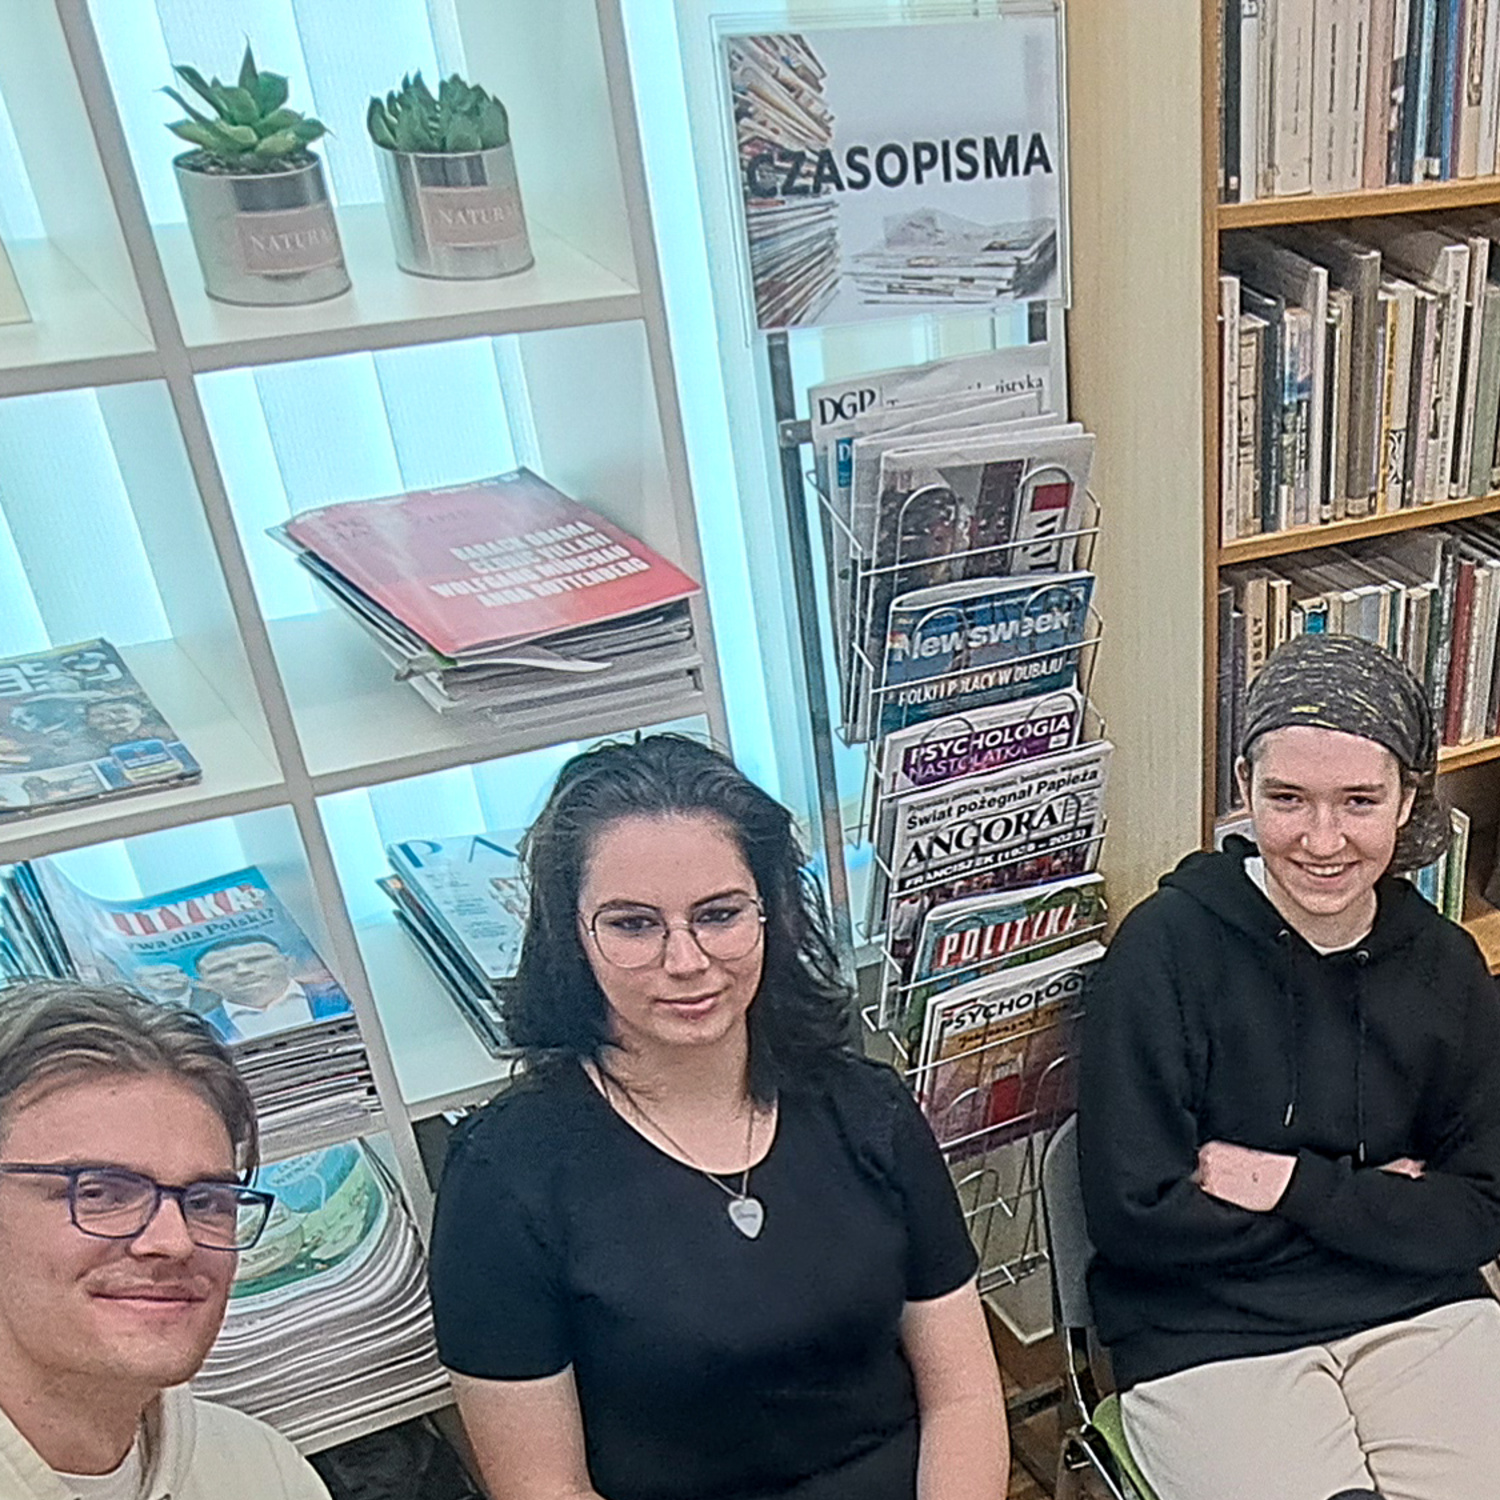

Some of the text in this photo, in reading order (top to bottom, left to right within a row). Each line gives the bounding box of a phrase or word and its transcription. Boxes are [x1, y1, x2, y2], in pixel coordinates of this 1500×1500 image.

[746, 133, 1052, 197] CZASOPISMA
[818, 389, 876, 426] DGP
[890, 611, 1073, 662] Newsweek
[1014, 657, 1064, 682] DUBAJU
[910, 714, 1072, 765] PSYCHOLOGIA
[907, 806, 952, 830] Świat
[956, 785, 1032, 818] pożegnał
[1036, 769, 1098, 794] Papieża
[903, 803, 1059, 868] ANGORA
[171, 930, 202, 946] dla
[942, 980, 1080, 1030] PSYCHOLOG
